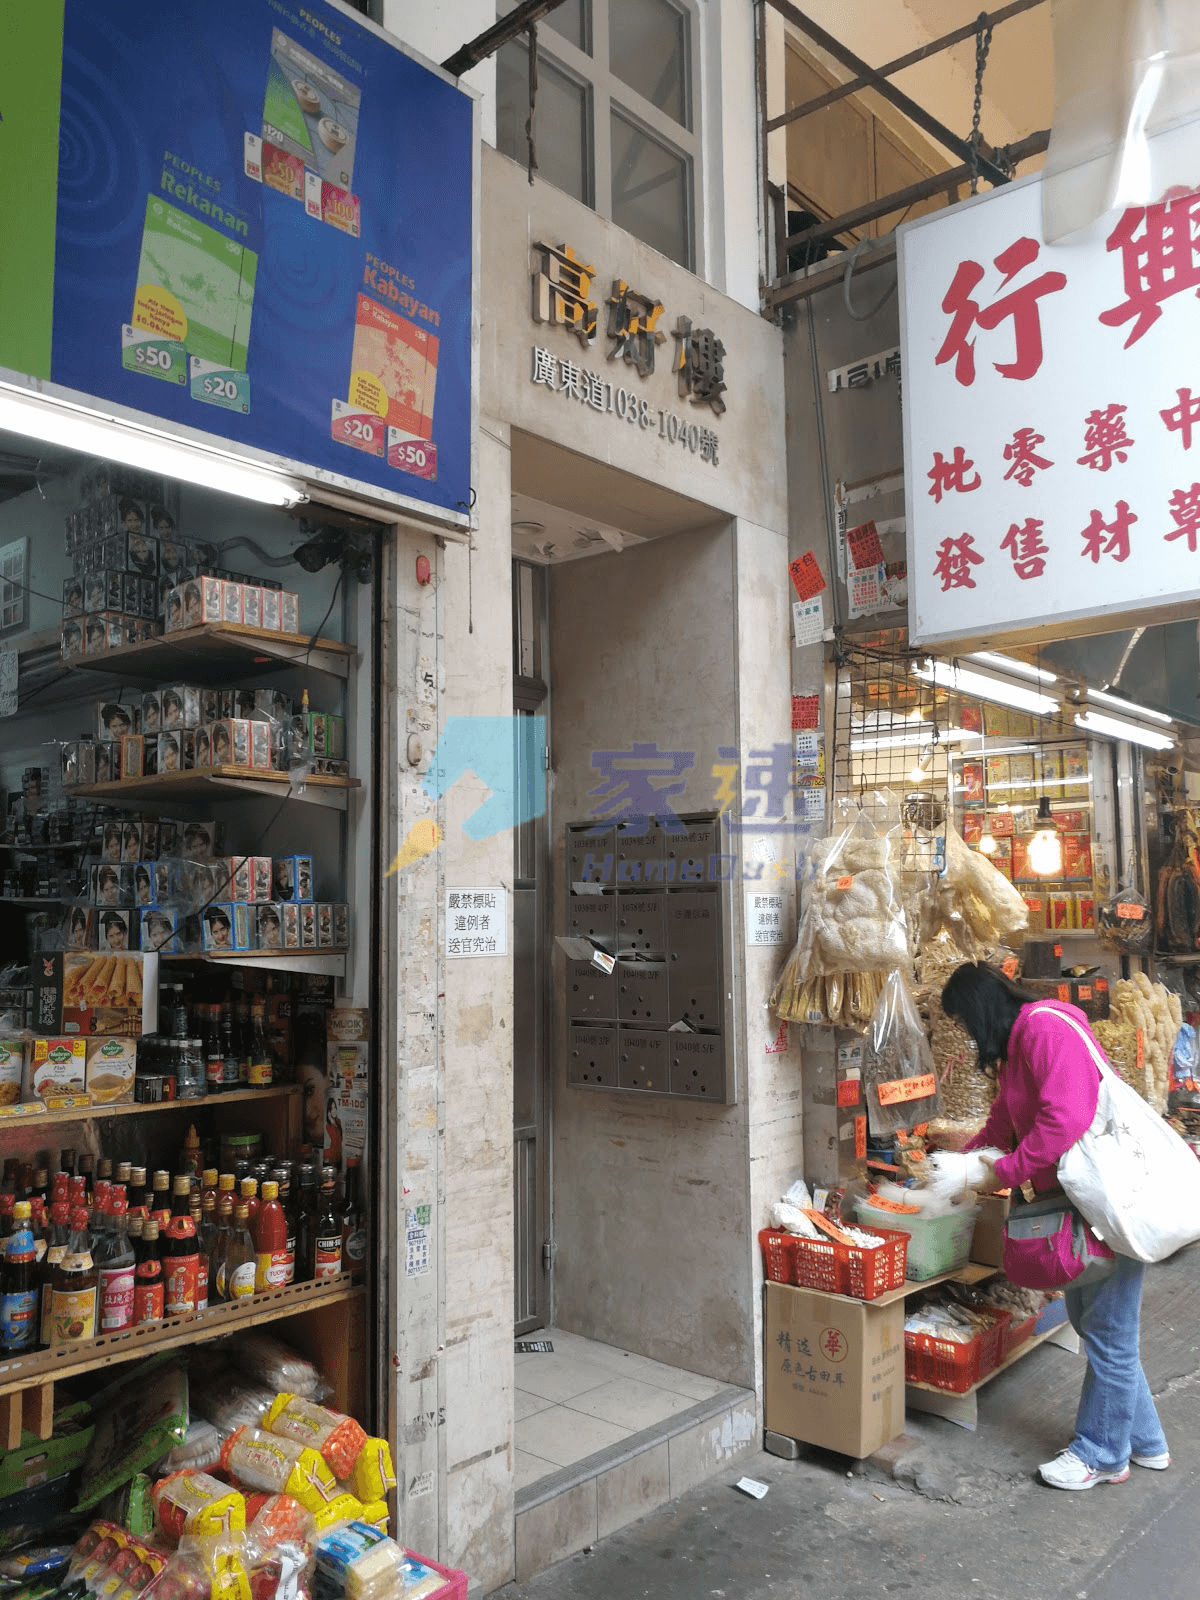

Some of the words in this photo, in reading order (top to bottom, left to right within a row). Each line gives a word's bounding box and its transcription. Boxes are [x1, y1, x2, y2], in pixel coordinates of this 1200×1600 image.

[300, 9, 341, 45] PEOPLES
[162, 150, 221, 193] PEOPLES
[160, 171, 249, 237] Rekanan
[365, 252, 416, 290] PEOPLES
[364, 265, 440, 328] Kabayan
[135, 346, 172, 370] $50
[204, 376, 238, 400] $20
[344, 419, 374, 442] $20
[398, 445, 426, 467] $50
[448, 893, 496, 909] 嚴禁標貼
[454, 914, 490, 931] 違例者
[448, 936, 497, 954] 送官究治
